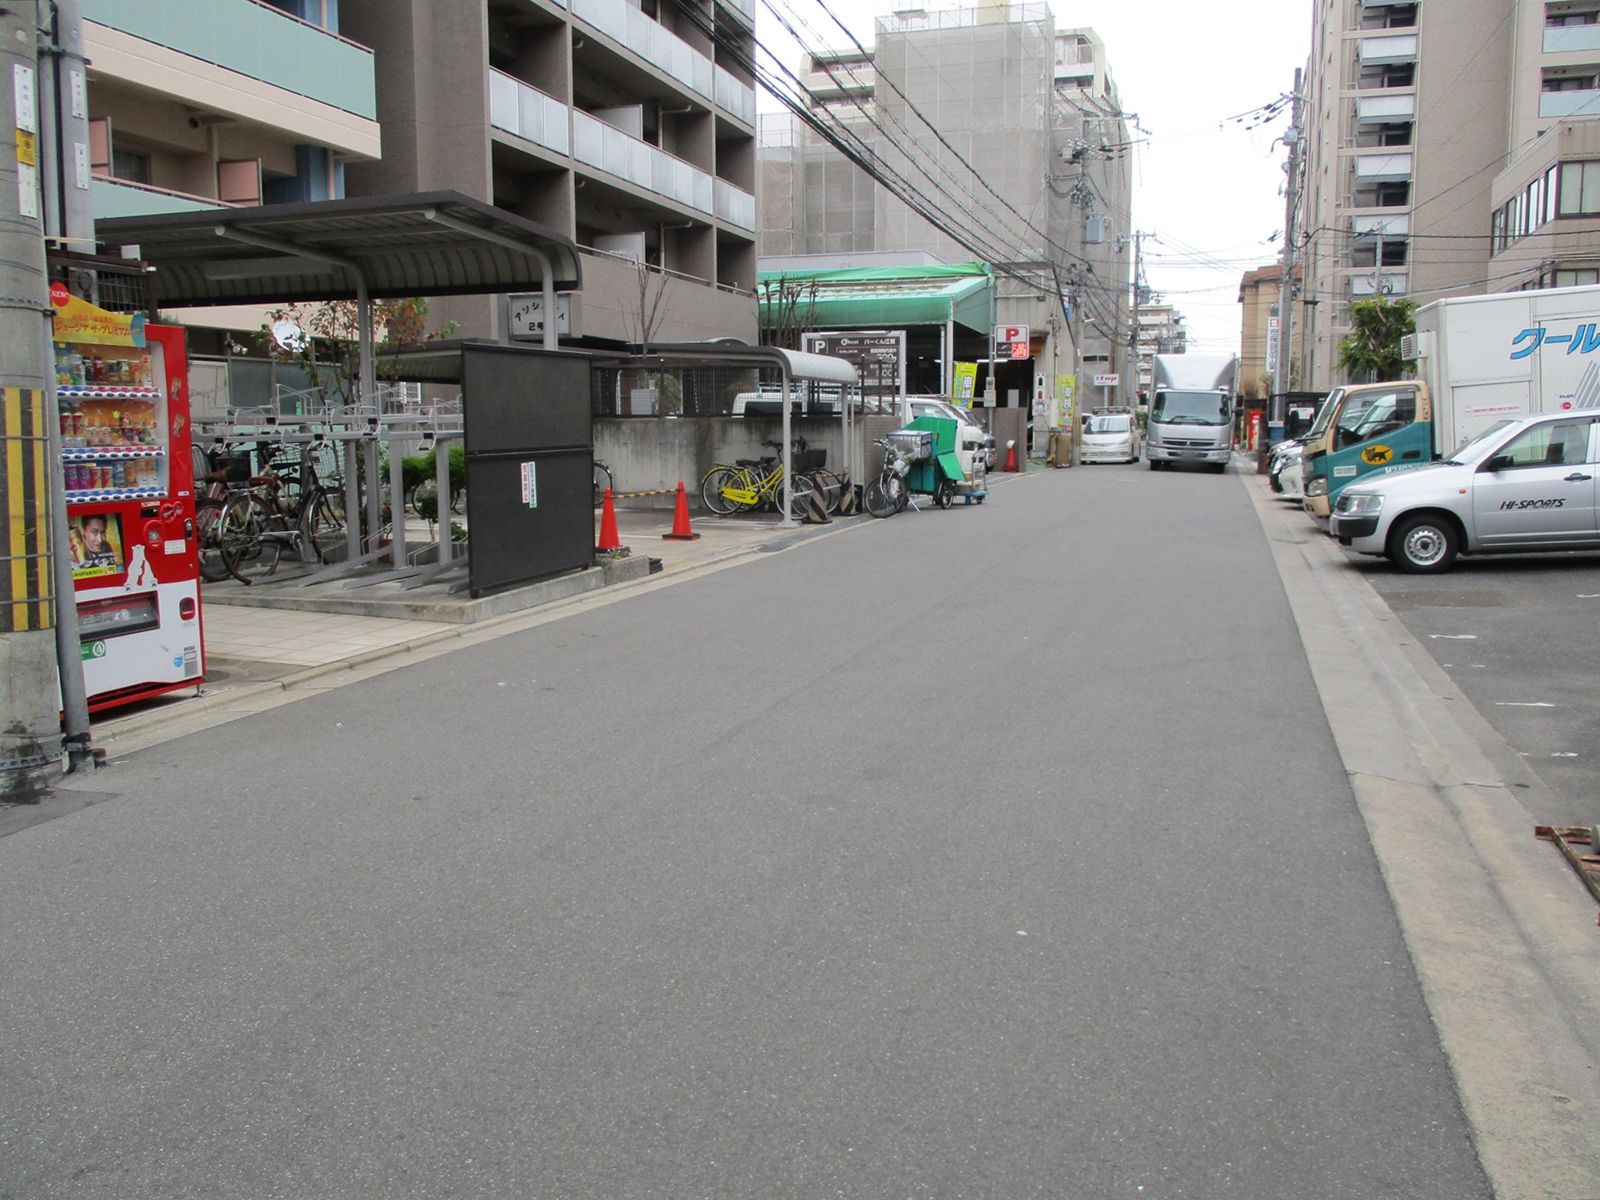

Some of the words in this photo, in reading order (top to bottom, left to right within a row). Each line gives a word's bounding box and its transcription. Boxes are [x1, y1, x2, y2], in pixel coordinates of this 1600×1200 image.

[1005, 328, 1020, 342] P
[1510, 323, 1600, 360] クール
[814, 340, 826, 354] P
[1500, 498, 1567, 510] HI-SPORTS
